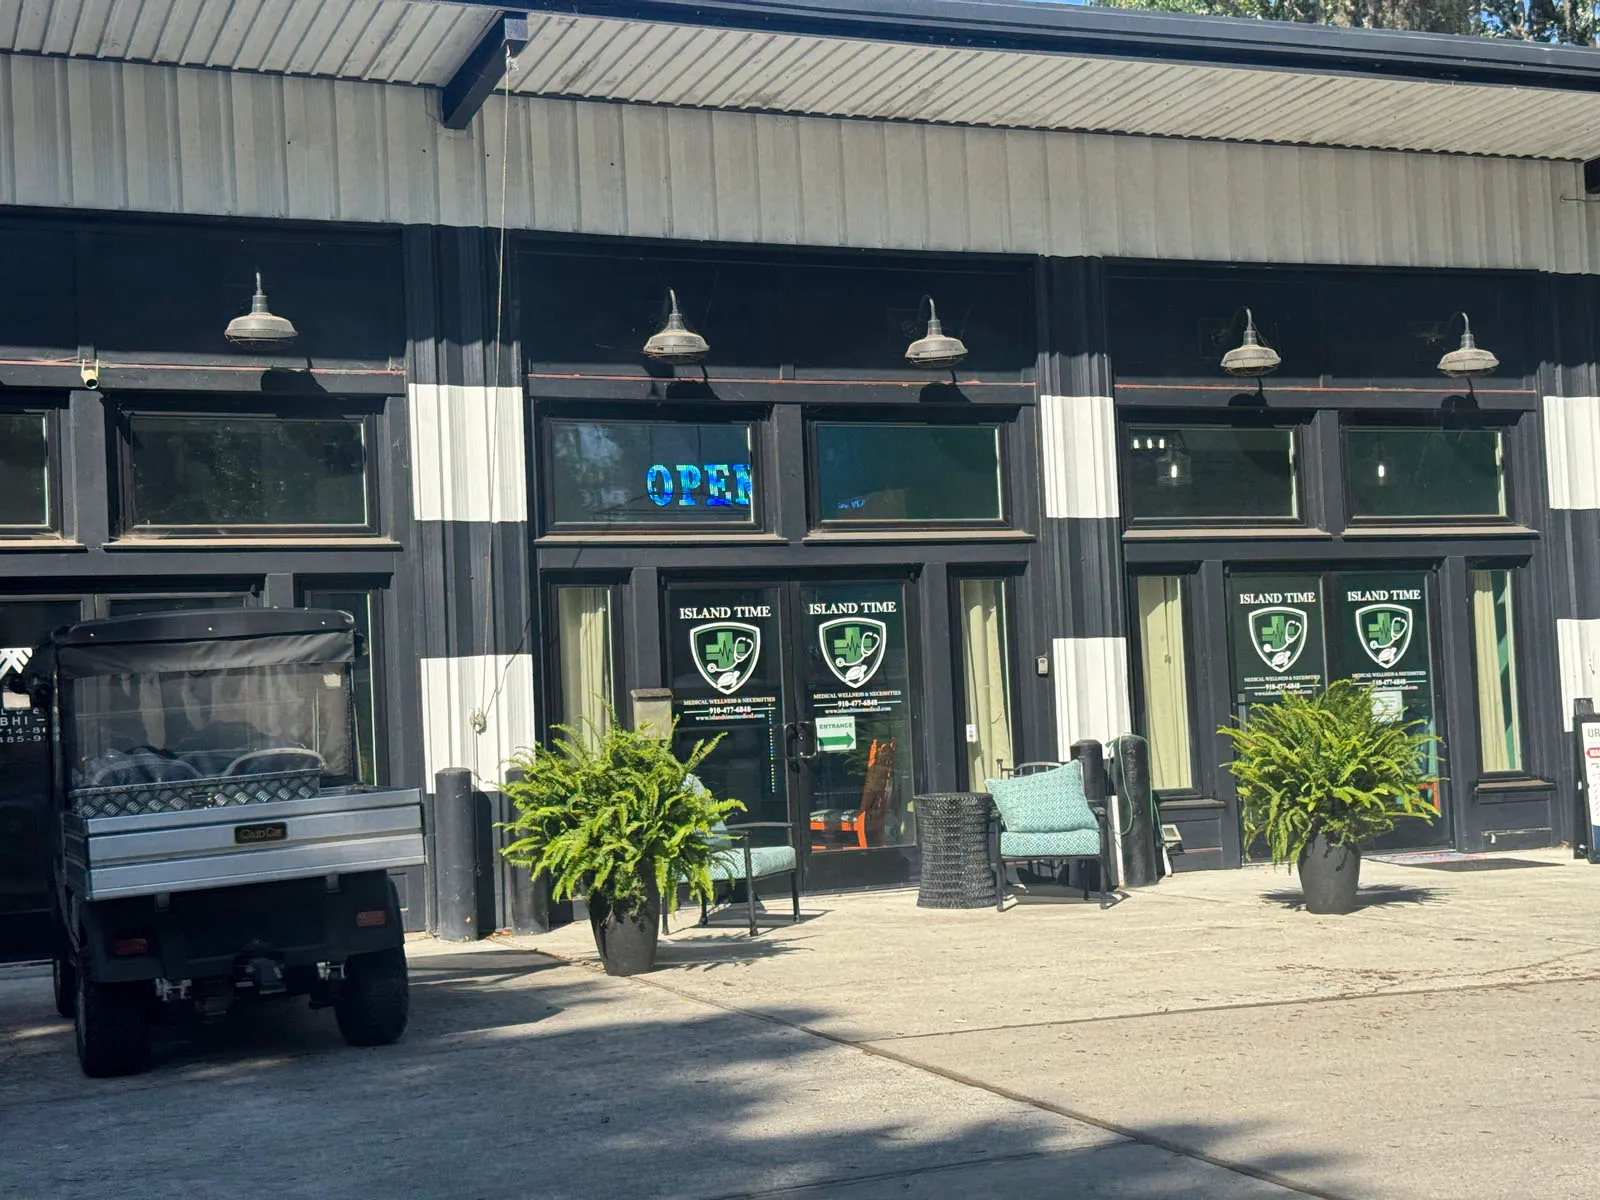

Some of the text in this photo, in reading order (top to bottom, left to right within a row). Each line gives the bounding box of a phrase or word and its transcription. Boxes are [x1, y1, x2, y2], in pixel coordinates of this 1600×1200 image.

[646, 464, 752, 506] OPEN
[1240, 591, 1316, 604] ISLAND TIME
[1347, 589, 1421, 601] ISLAND TIME
[679, 606, 771, 619] ISLAND TIME
[809, 601, 897, 615] ISLAND TIME
